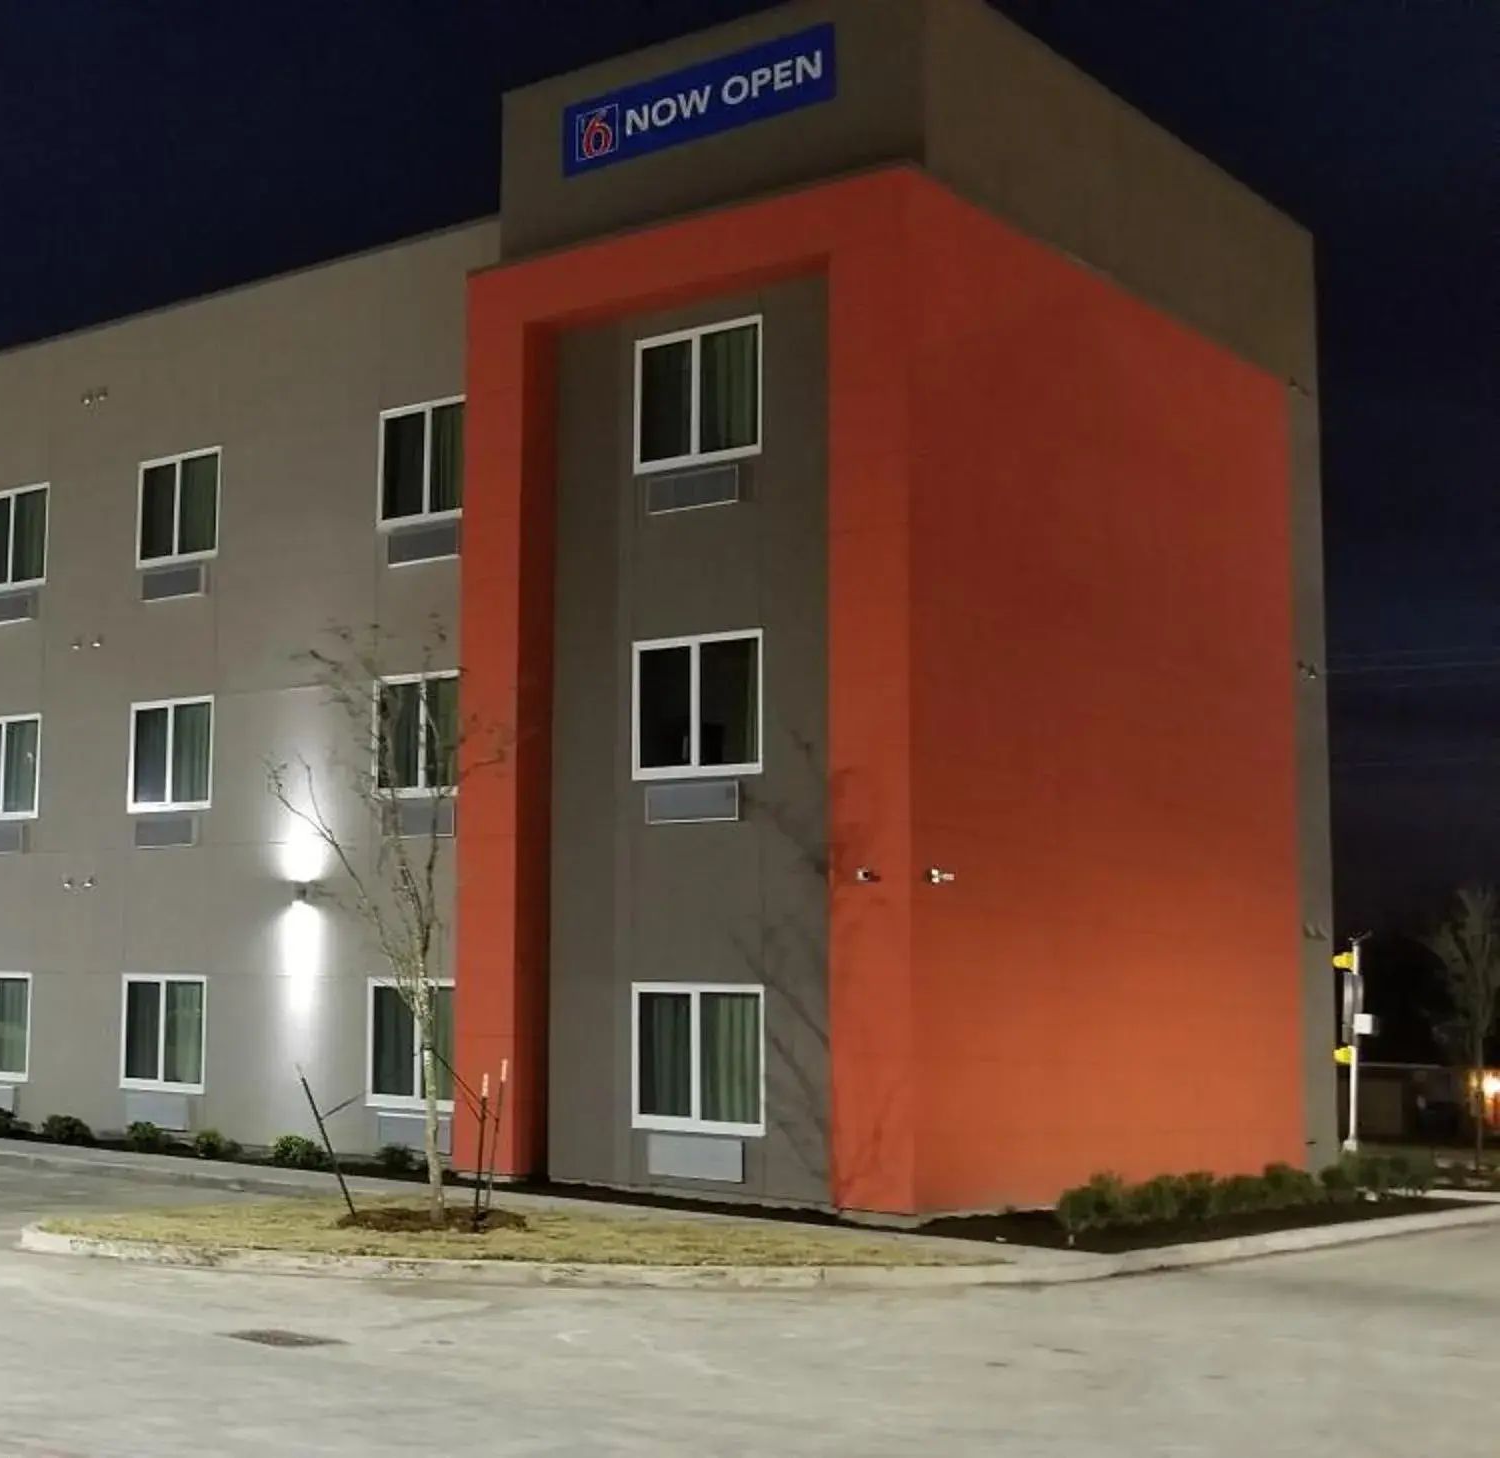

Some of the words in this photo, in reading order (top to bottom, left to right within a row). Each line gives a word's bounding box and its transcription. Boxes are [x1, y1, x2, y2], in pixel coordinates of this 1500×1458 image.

[582, 108, 613, 159] 6
[625, 84, 713, 136] NOW
[721, 50, 823, 105] OPEN
